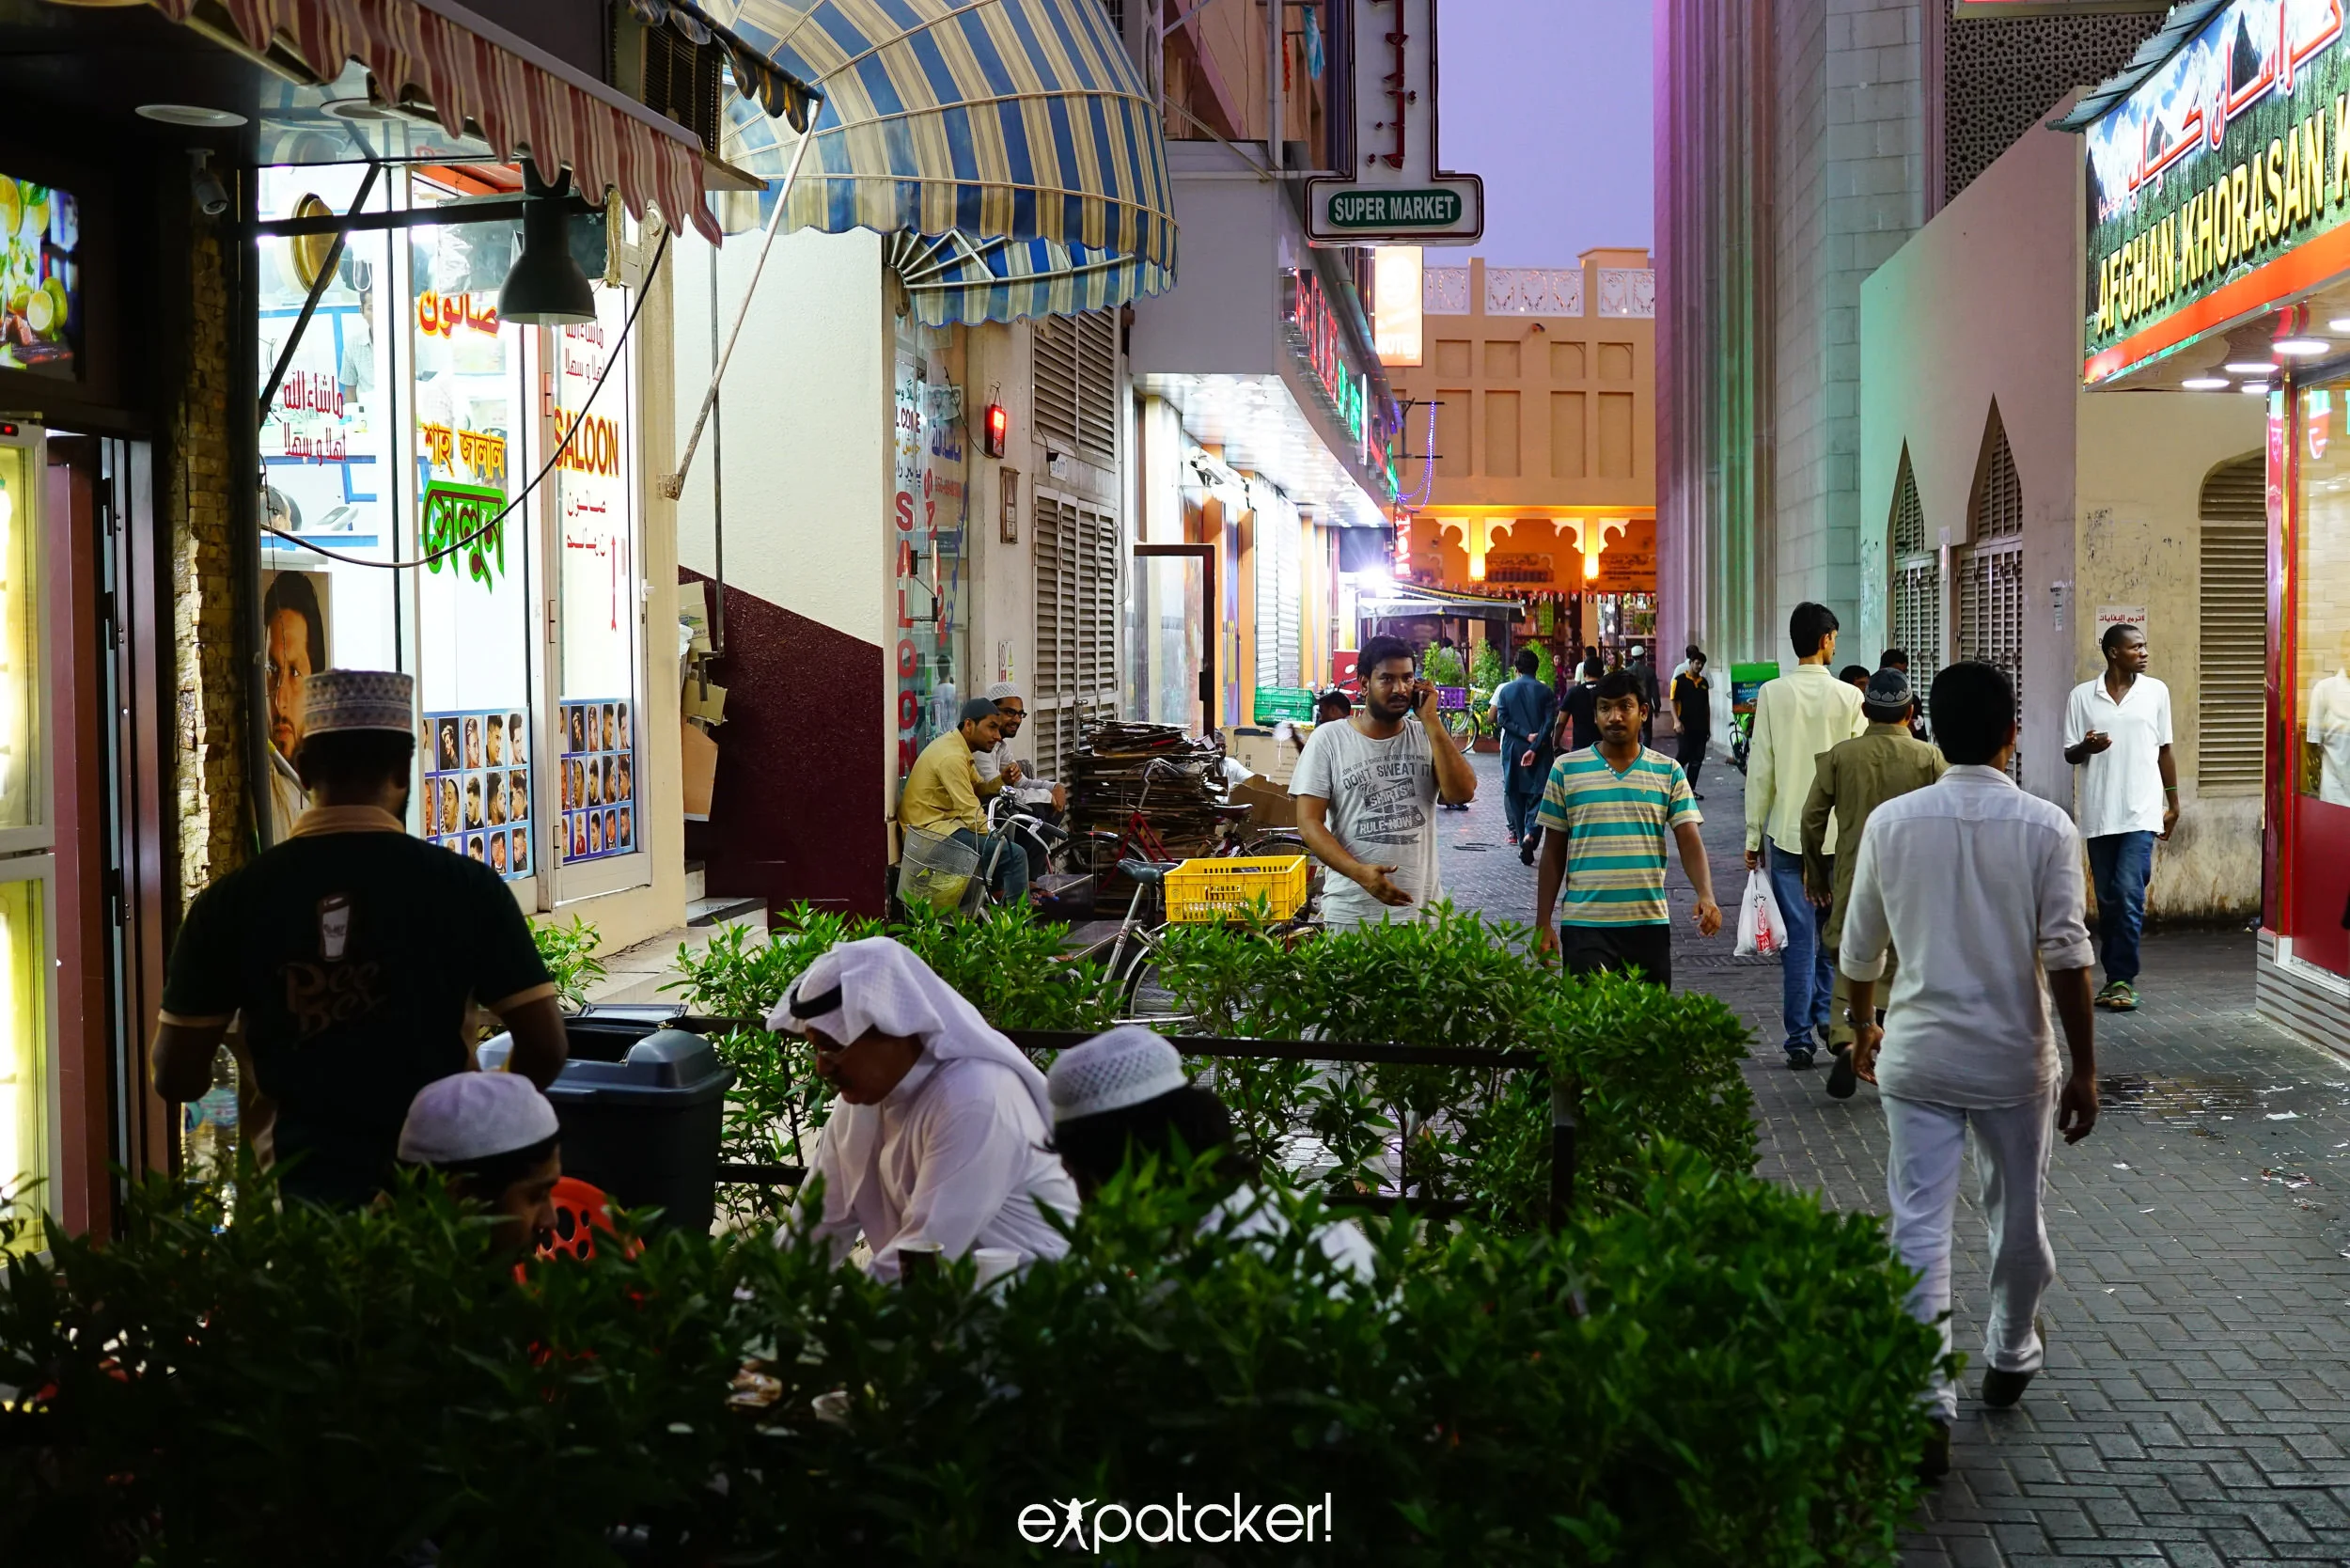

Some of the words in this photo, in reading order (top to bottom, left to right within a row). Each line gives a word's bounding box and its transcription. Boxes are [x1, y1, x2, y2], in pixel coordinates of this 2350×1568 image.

[1334, 196, 1386, 222] SUPER
[1390, 196, 1455, 221] MARKET
[2097, 212, 2176, 337] AFGHAN
[2181, 108, 2326, 290] KHORASAN
[418, 290, 500, 340] صالون
[421, 420, 455, 478] শাহ
[457, 427, 506, 479] জালাল
[554, 406, 620, 478] SALOON
[896, 491, 918, 776] SALOON
[1377, 762, 1416, 777] SWEAT
[1421, 763, 1430, 777] IT
